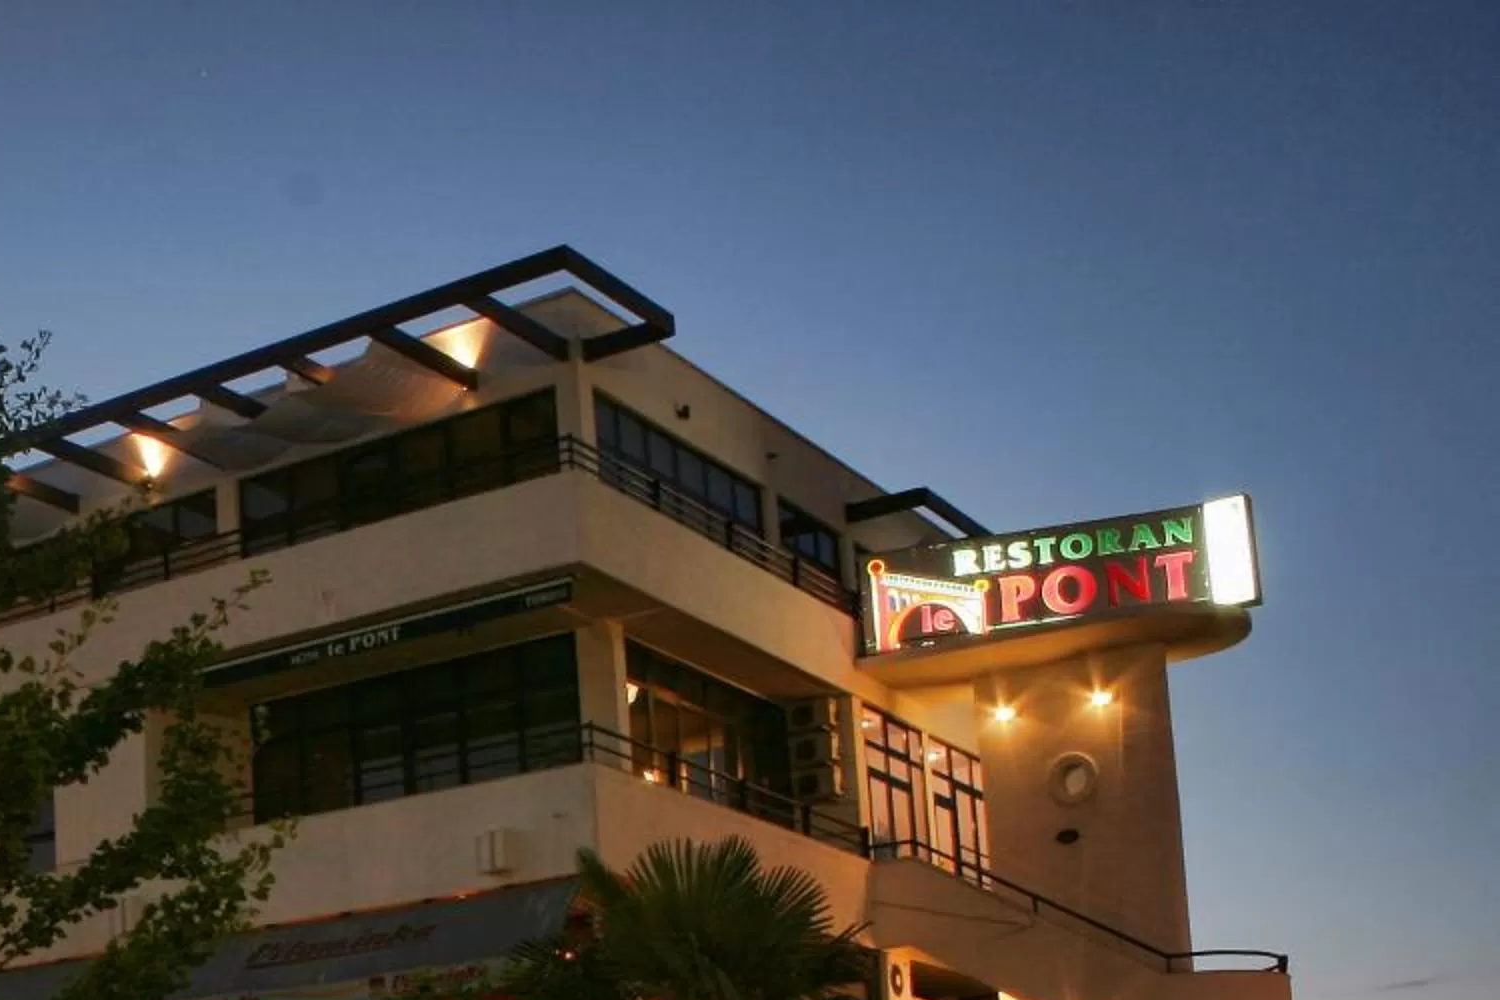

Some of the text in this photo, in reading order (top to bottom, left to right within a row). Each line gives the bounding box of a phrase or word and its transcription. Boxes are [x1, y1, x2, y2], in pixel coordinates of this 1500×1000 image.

[952, 516, 1194, 577] RESTORAN
[921, 551, 1194, 633] le PONT
[349, 626, 401, 653] PONT
